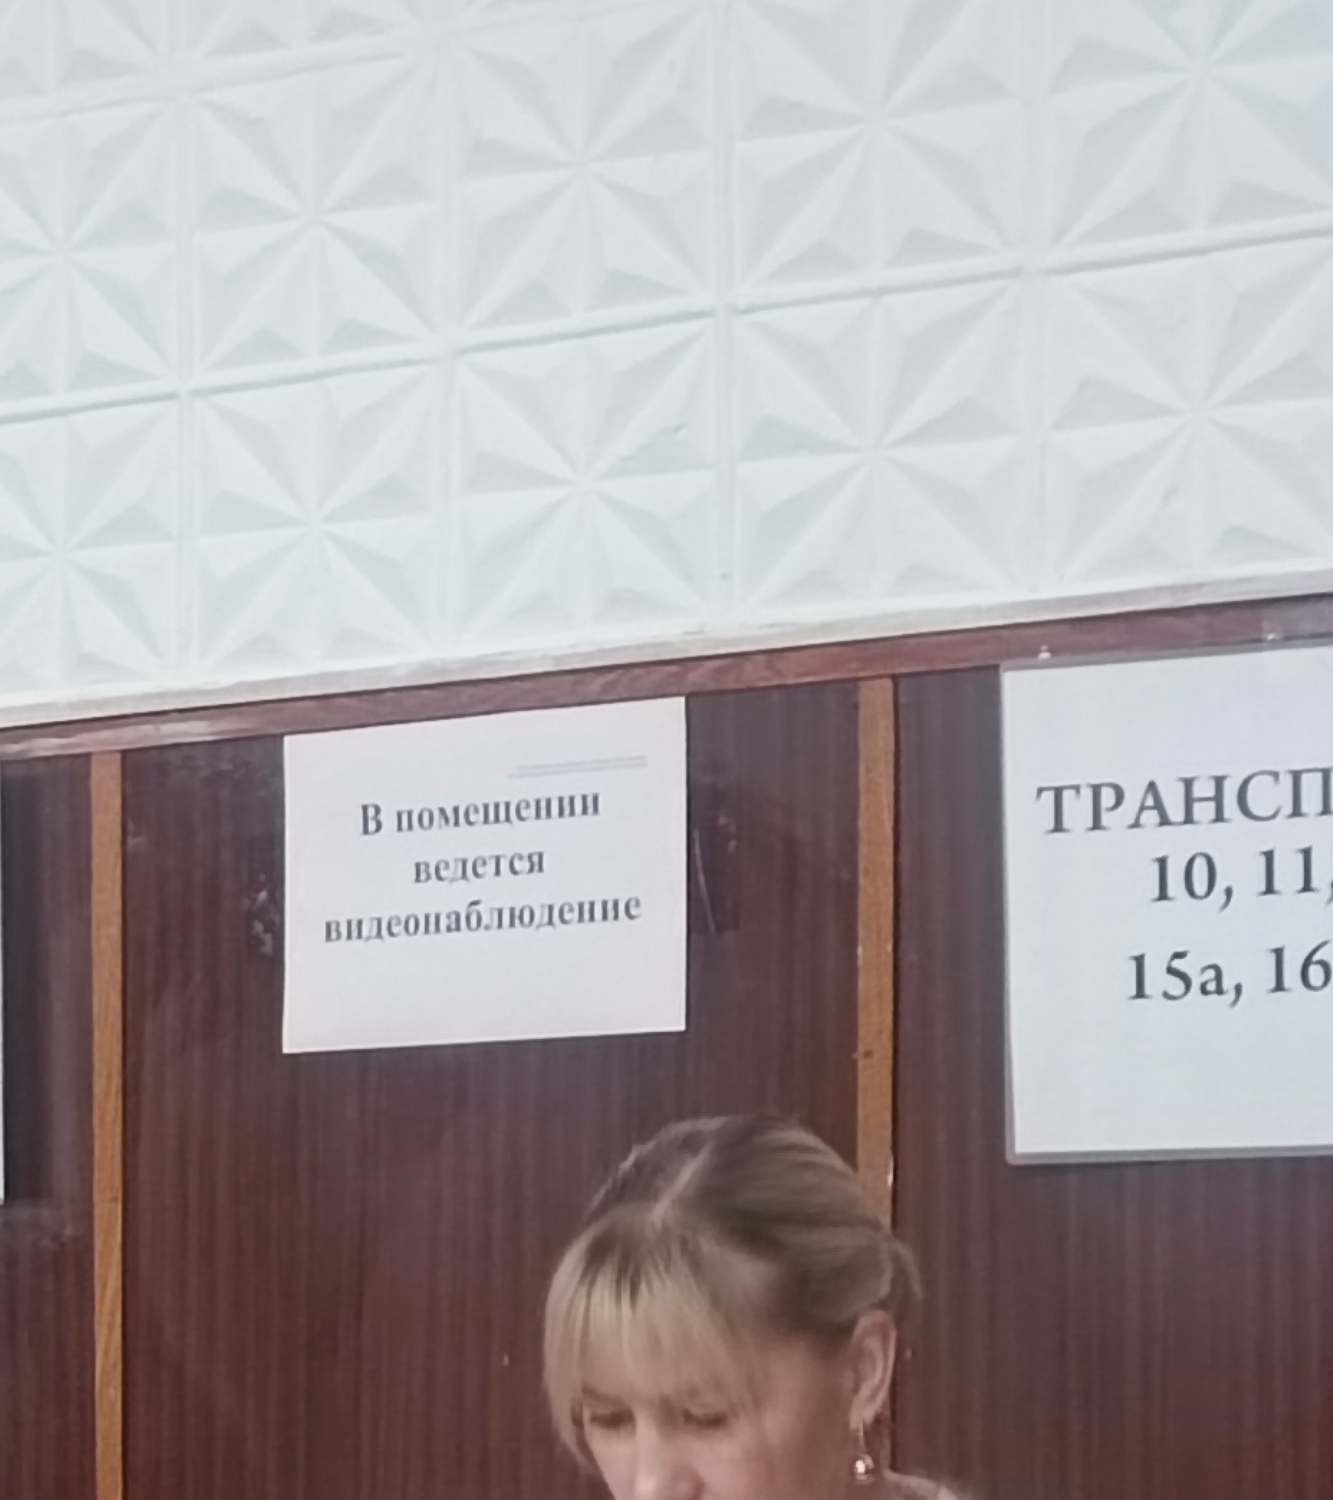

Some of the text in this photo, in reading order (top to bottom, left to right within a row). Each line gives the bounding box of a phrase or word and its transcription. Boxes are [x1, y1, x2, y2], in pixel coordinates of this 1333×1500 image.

[360, 792, 601, 836] В помещении
[1035, 766, 1333, 834] ТРАНСП
[413, 850, 545, 884] ведется
[1151, 852, 1234, 913] 10,
[324, 895, 642, 943] видеонаблюдение
[1128, 950, 1244, 1008] 15а,
